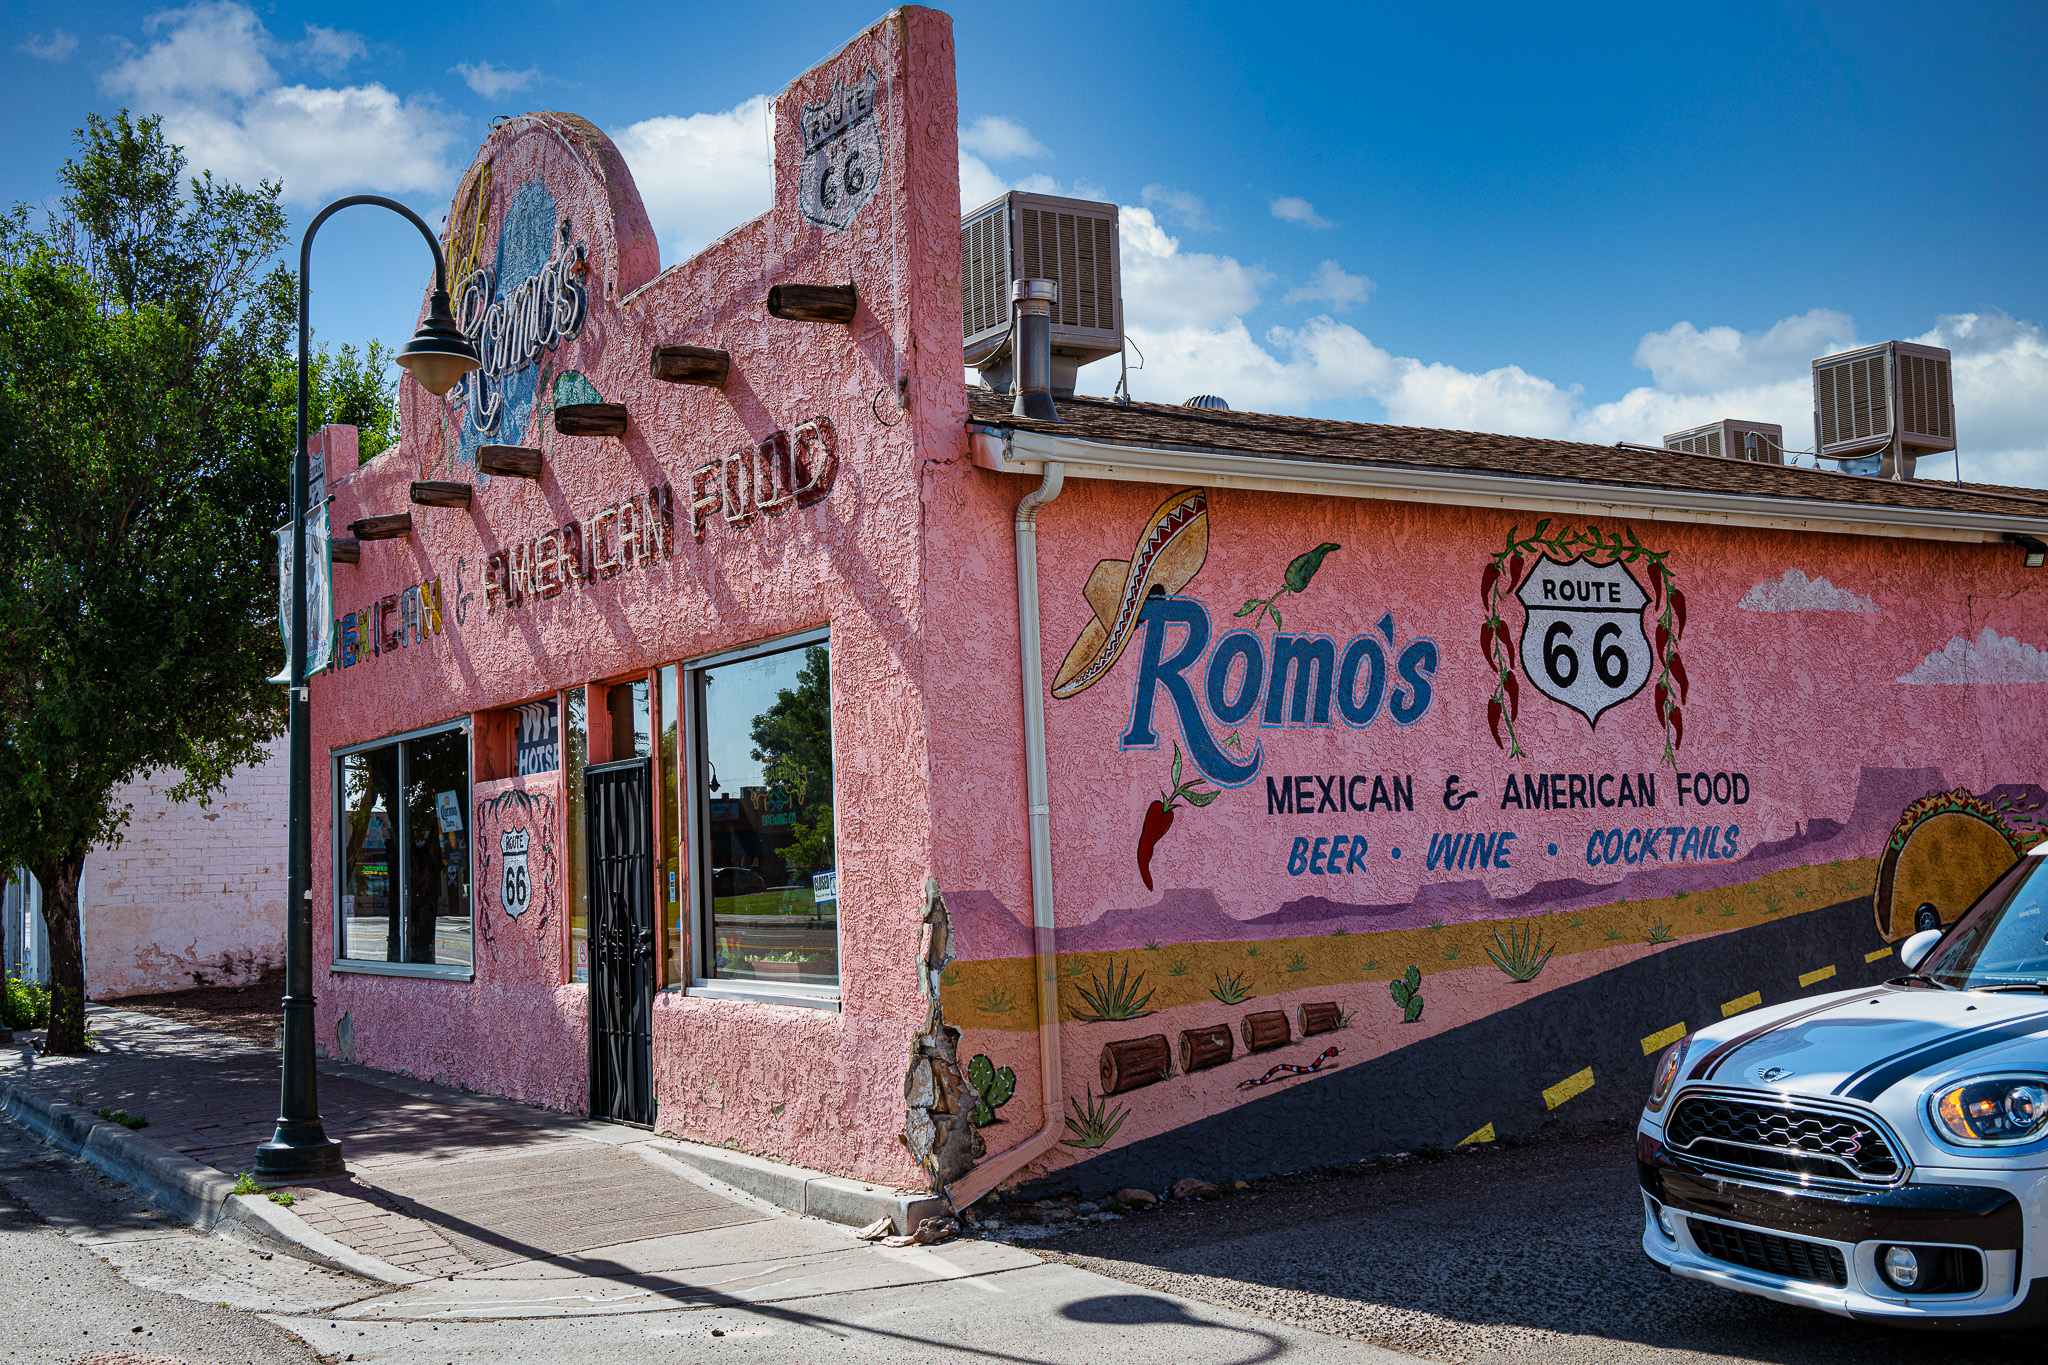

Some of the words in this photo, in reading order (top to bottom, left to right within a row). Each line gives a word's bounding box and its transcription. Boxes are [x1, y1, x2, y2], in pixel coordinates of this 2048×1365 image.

[812, 89, 867, 142] ROUTE
[831, 138, 848, 159] US
[820, 150, 864, 210] 66
[456, 556, 474, 627] &
[482, 481, 675, 616] AMERICAN
[690, 416, 839, 545] FOOD
[1542, 578, 1622, 603] ROUTE
[1542, 620, 1629, 689] 66
[1118, 594, 1440, 790] Romo's
[441, 805, 458, 821] Corona
[1266, 774, 1414, 816] MEXICAN
[1443, 775, 1479, 811] &
[1500, 772, 1657, 811] AMERICAN
[1676, 771, 1751, 806] FOOD
[506, 835, 524, 850] ROUTE
[1286, 835, 1368, 876] BEER
[1426, 830, 1517, 871] WINE
[1586, 825, 1739, 866] COCKTAILS
[506, 865, 526, 906] 66
